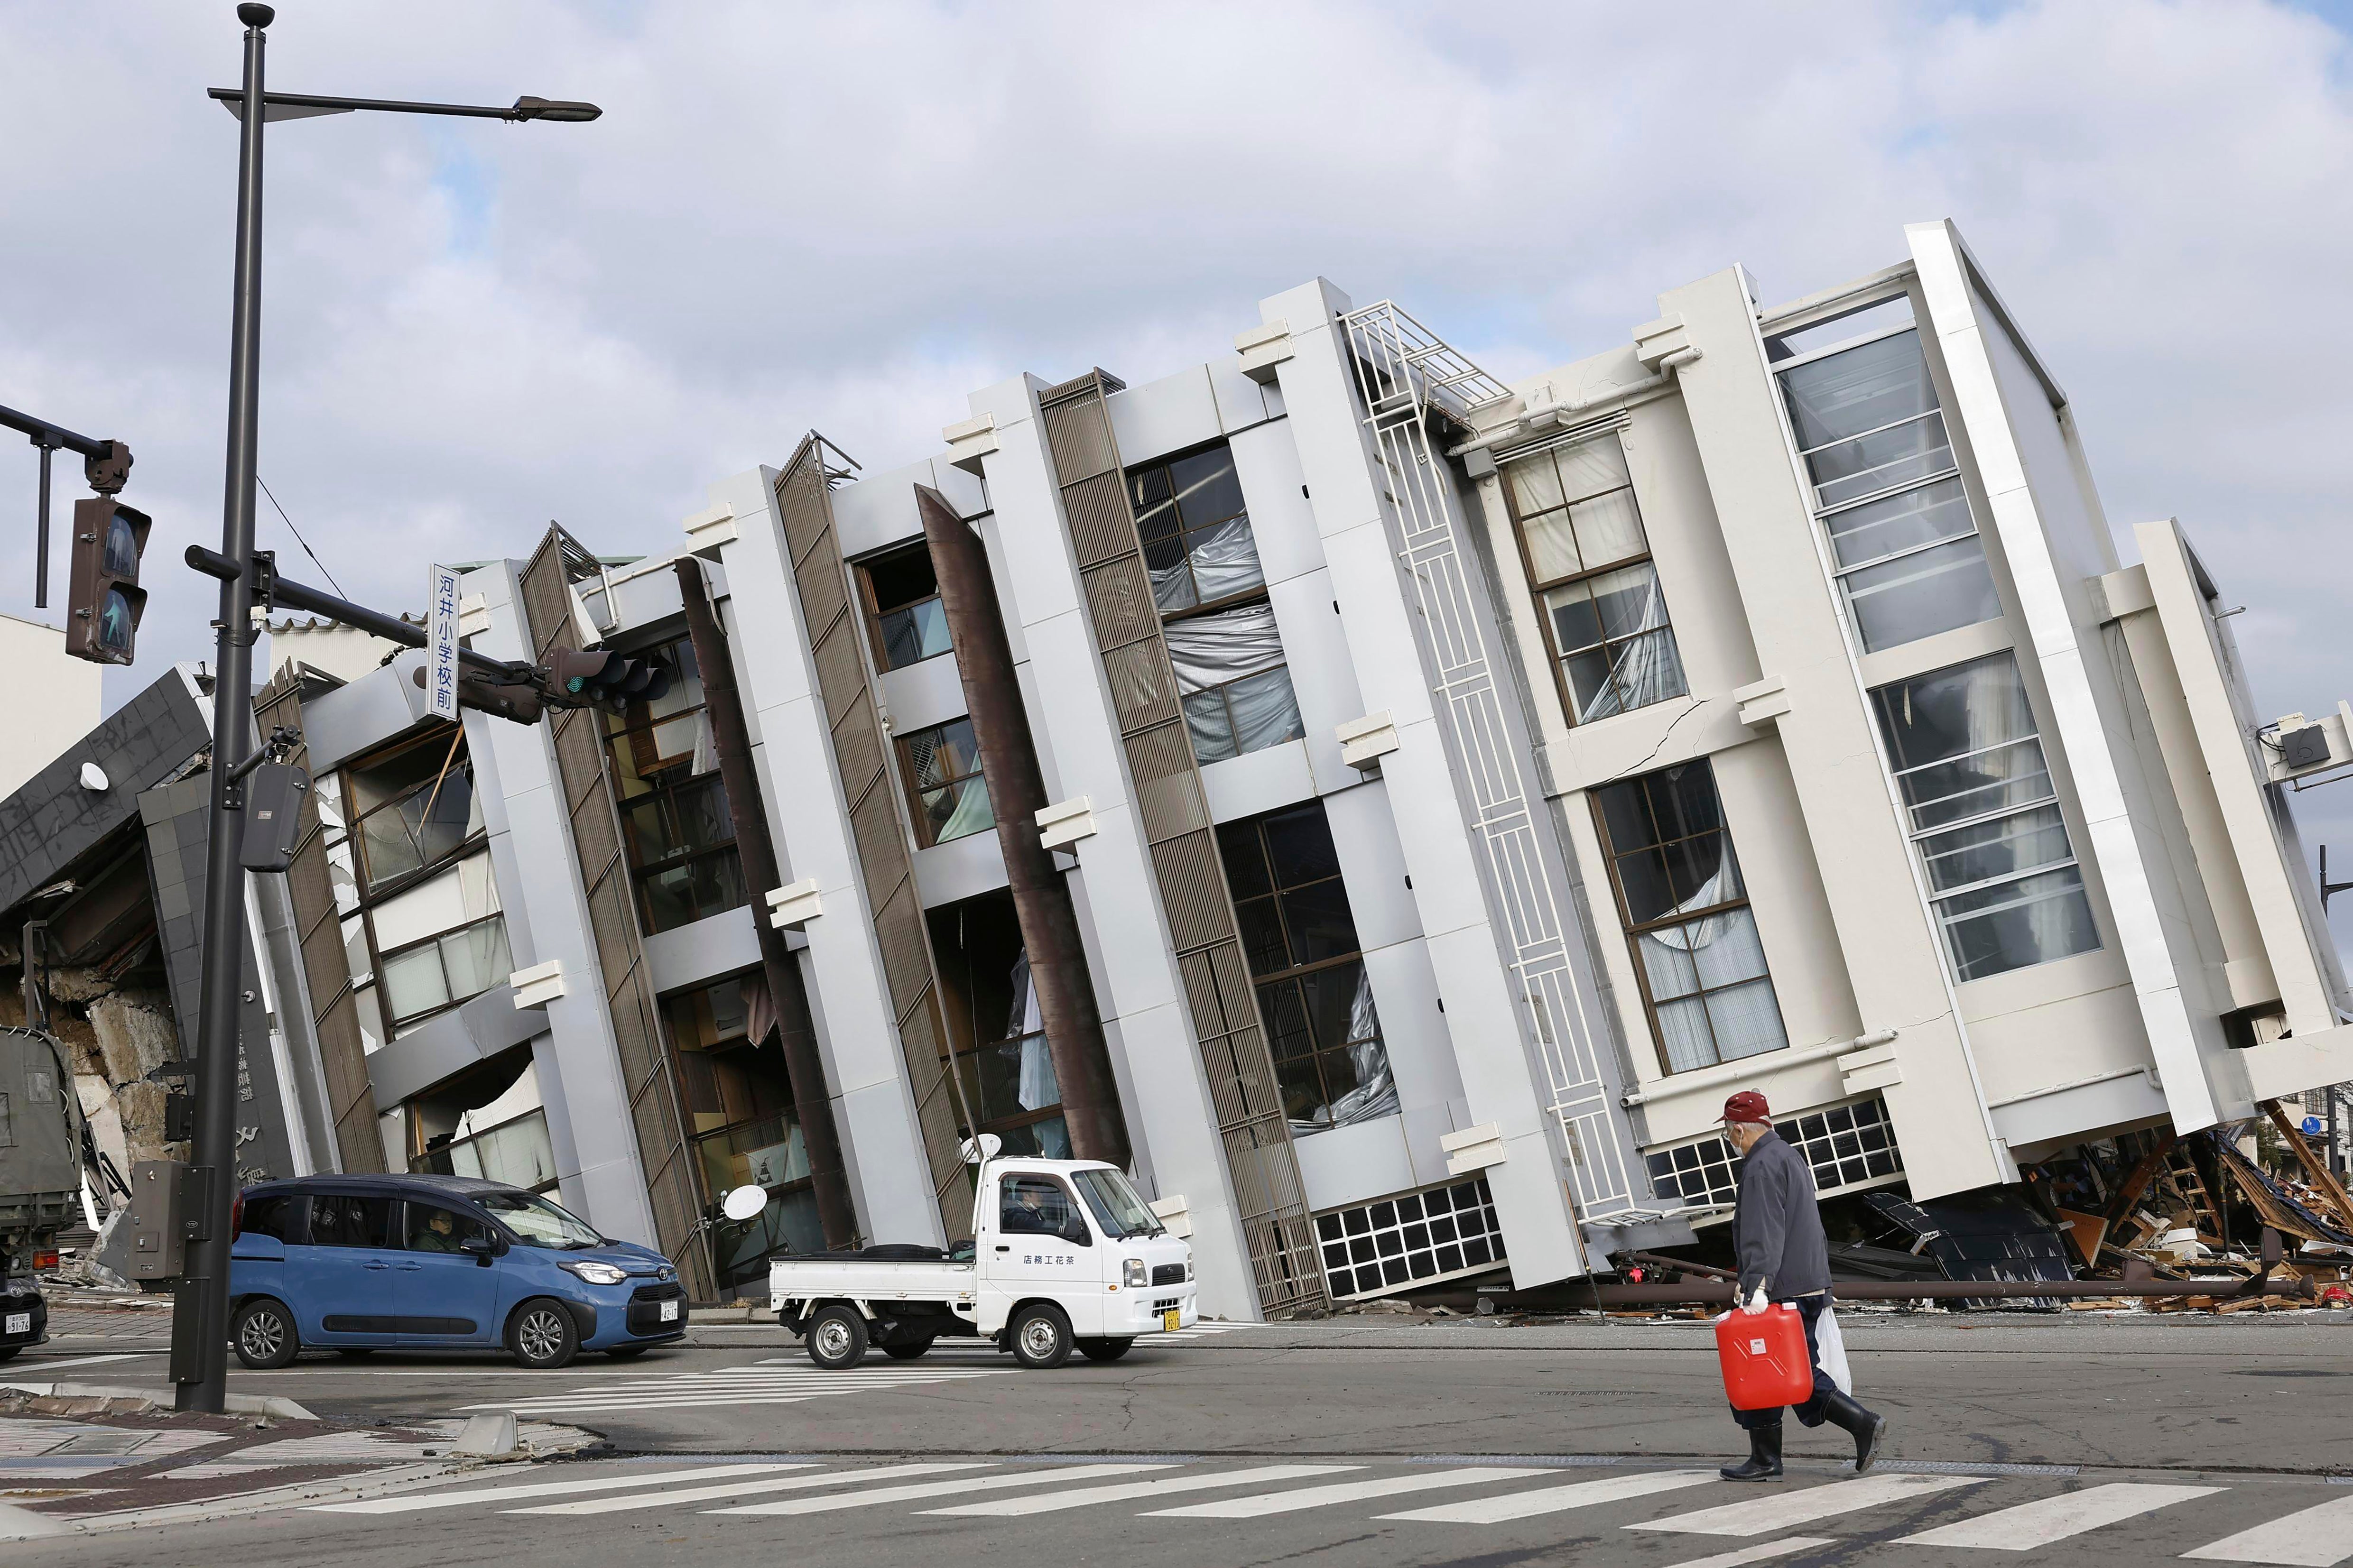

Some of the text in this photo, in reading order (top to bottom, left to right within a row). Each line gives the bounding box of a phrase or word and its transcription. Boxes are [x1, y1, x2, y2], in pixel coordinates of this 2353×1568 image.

[437, 574, 454, 710] 河井小学校前
